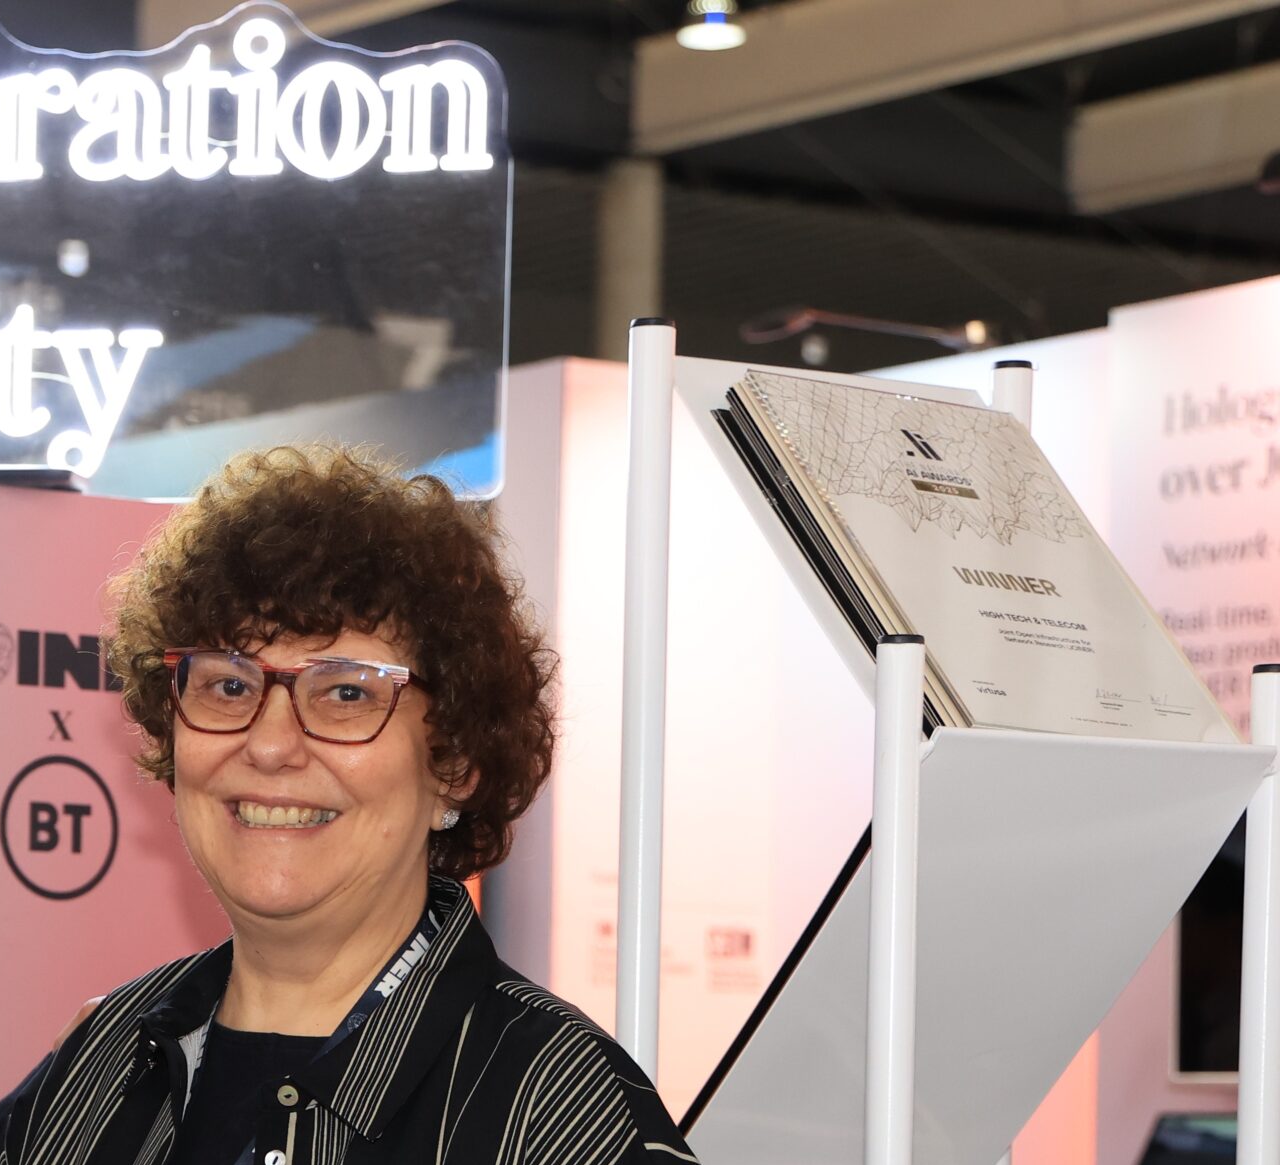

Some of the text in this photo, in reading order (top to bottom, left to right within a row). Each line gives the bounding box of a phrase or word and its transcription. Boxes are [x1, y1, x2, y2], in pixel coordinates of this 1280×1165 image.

[906, 468, 919, 478] AI
[1159, 463, 1245, 501] over
[952, 566, 1063, 597] WINNER
[979, 609, 1088, 631] HIGH TECH & TELECOM
[48, 709, 73, 742] X
[29, 800, 92, 854] BT
